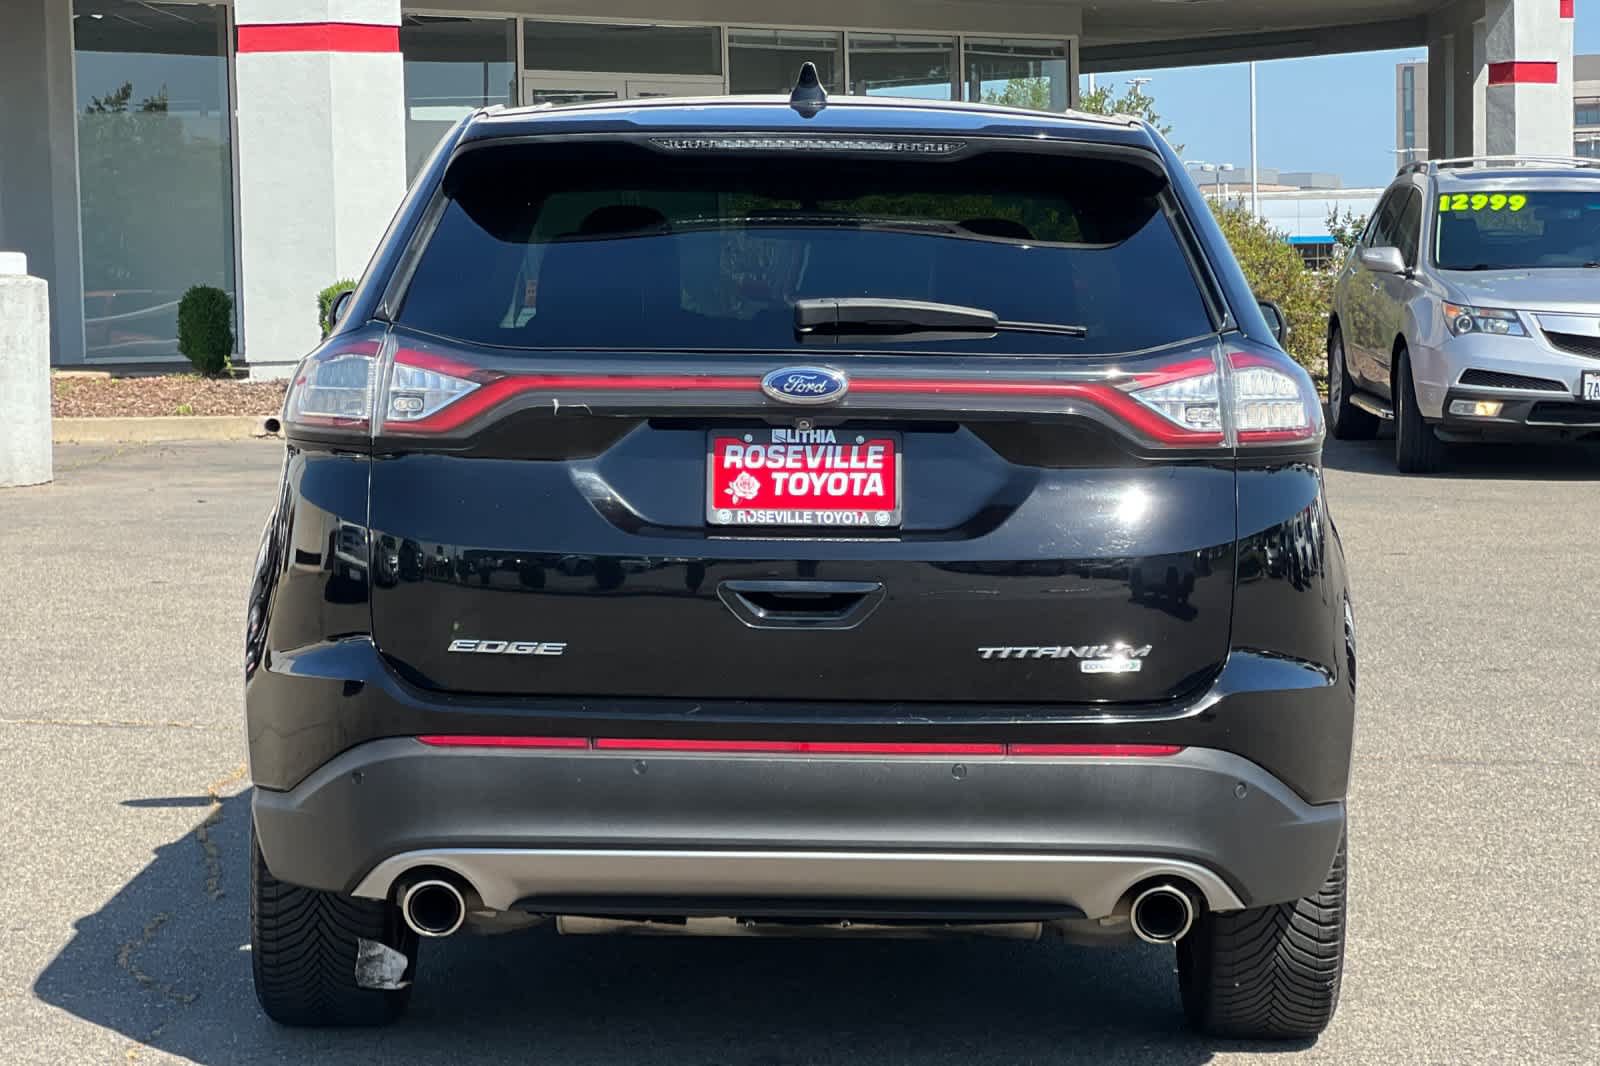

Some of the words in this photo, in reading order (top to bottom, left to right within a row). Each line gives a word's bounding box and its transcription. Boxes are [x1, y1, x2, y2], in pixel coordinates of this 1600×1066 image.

[1439, 193, 1527, 212] 12999
[783, 374, 827, 394] Ford
[787, 429, 836, 444] LITHIA
[723, 445, 885, 469] ROSEVILLE
[771, 472, 884, 496] TOYOTA
[737, 510, 813, 524] ROSEVILLE
[815, 511, 870, 524] TOYOTA
[447, 639, 568, 656] EDGE
